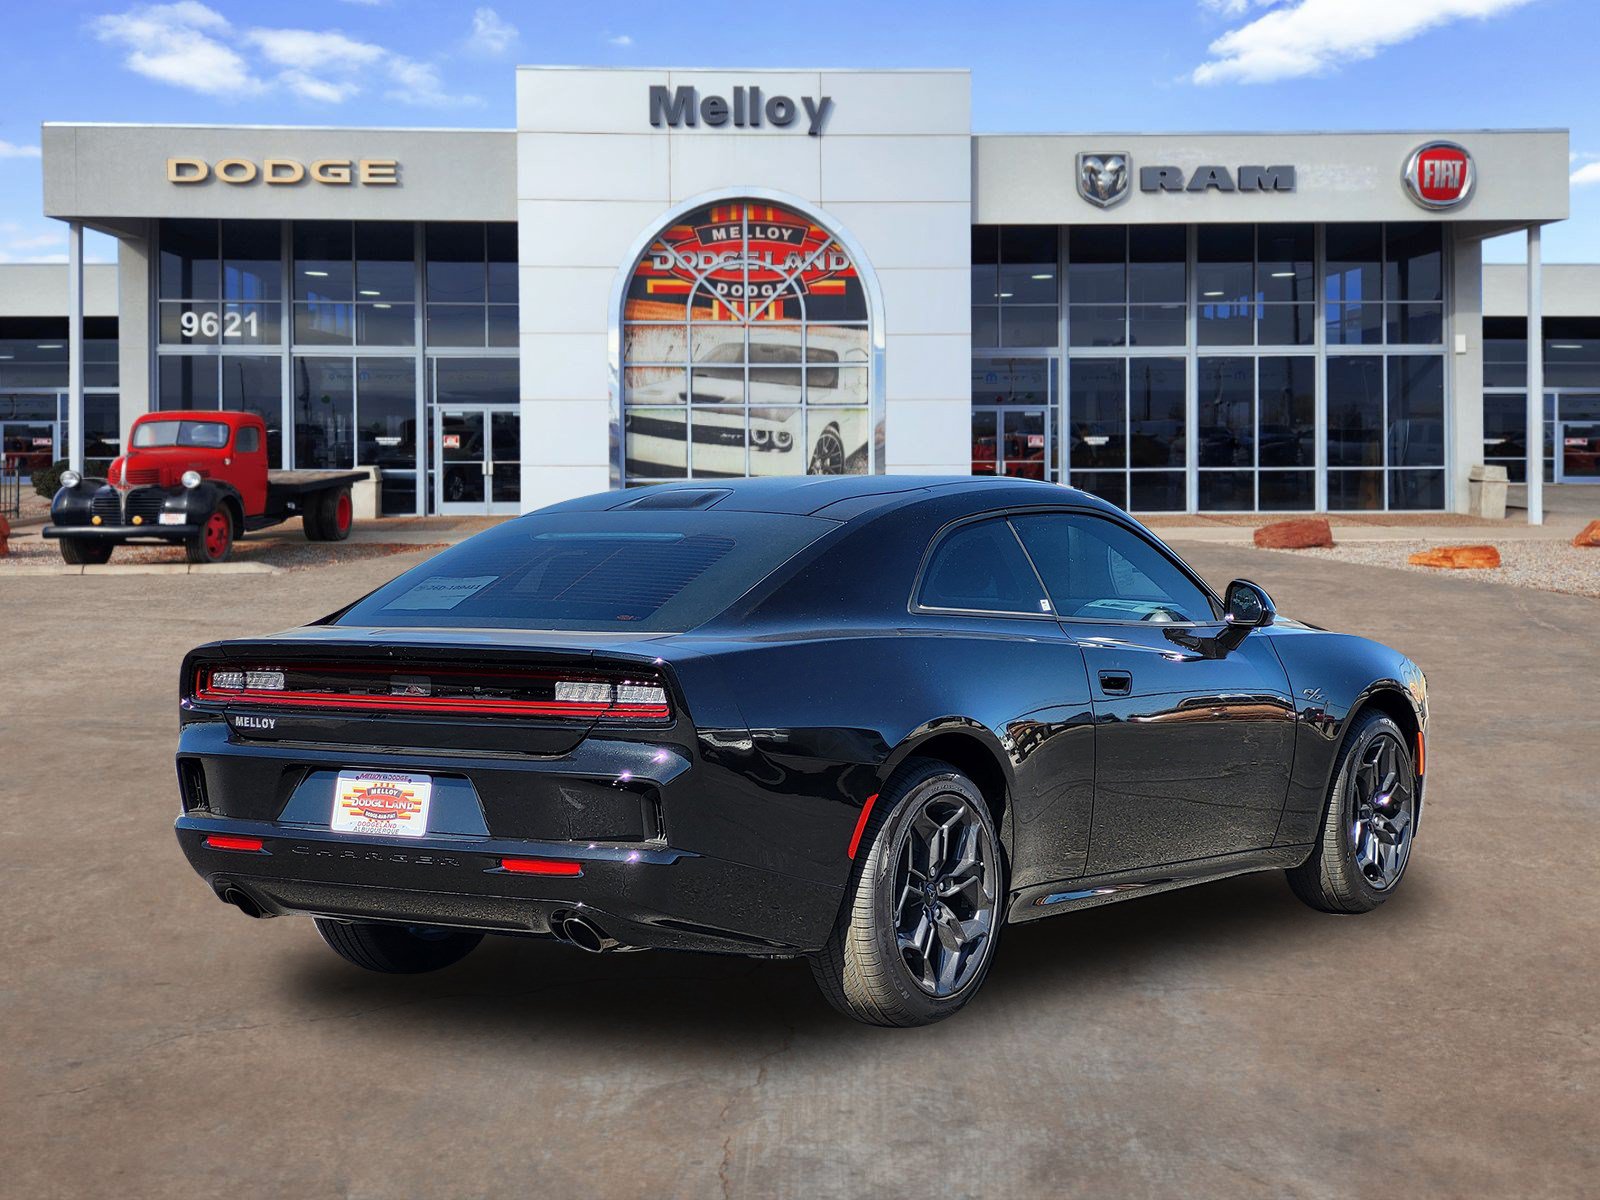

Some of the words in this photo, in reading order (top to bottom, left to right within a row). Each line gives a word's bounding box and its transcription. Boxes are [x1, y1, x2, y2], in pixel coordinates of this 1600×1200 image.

[649, 85, 832, 136] Melloy
[167, 158, 398, 186] DODGE
[1139, 164, 1296, 192] RAM
[1423, 159, 1464, 189] FIAT
[180, 311, 258, 338] 9621
[235, 716, 276, 729] MELLOY
[371, 788, 398, 797] MELLOY
[353, 826, 400, 835] ALBUQUERQUE
